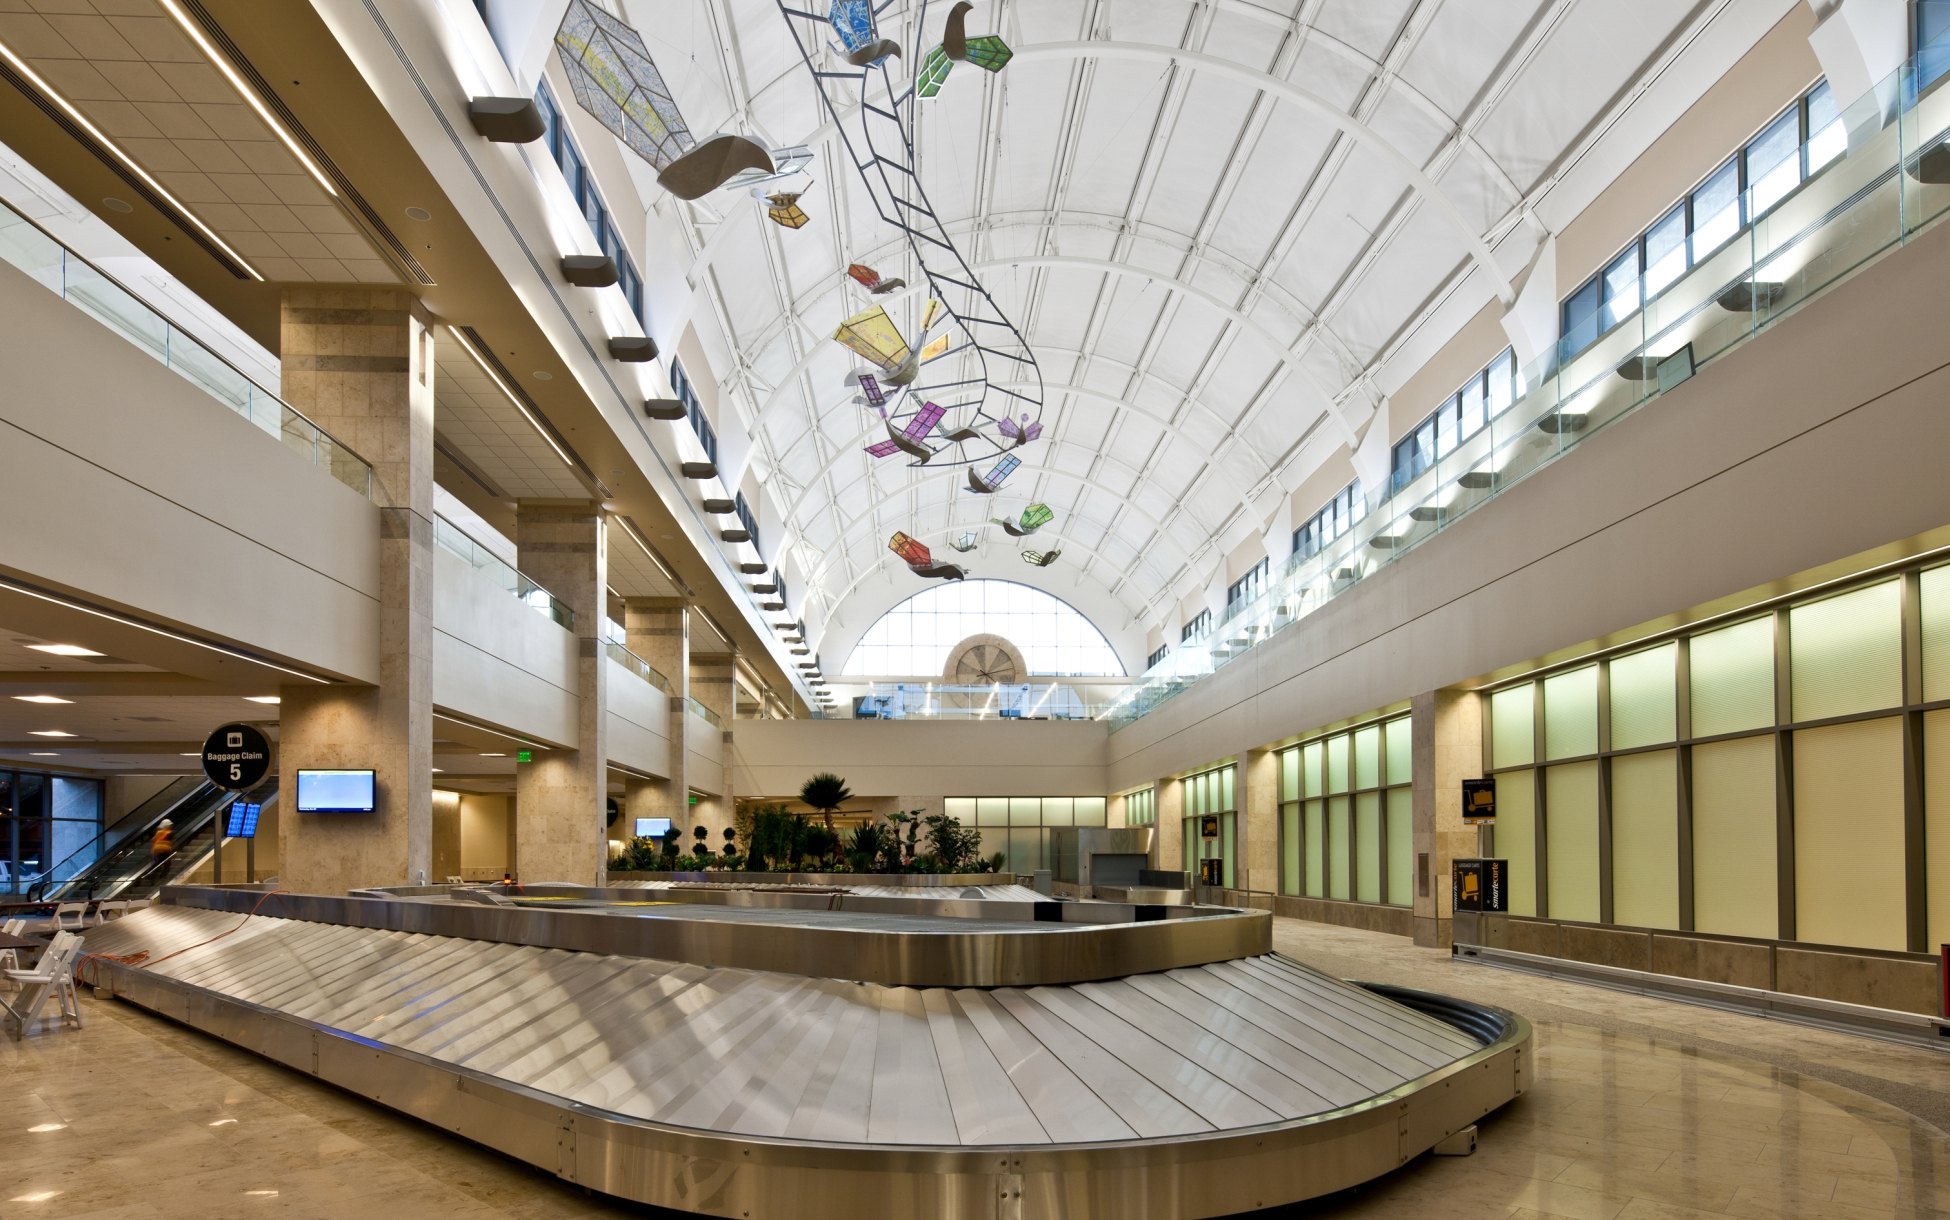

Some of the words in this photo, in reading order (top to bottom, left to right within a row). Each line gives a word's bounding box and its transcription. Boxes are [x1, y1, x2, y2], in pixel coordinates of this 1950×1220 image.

[207, 753, 240, 761] Baggage
[241, 752, 263, 760] Claim
[230, 764, 241, 780] 5
